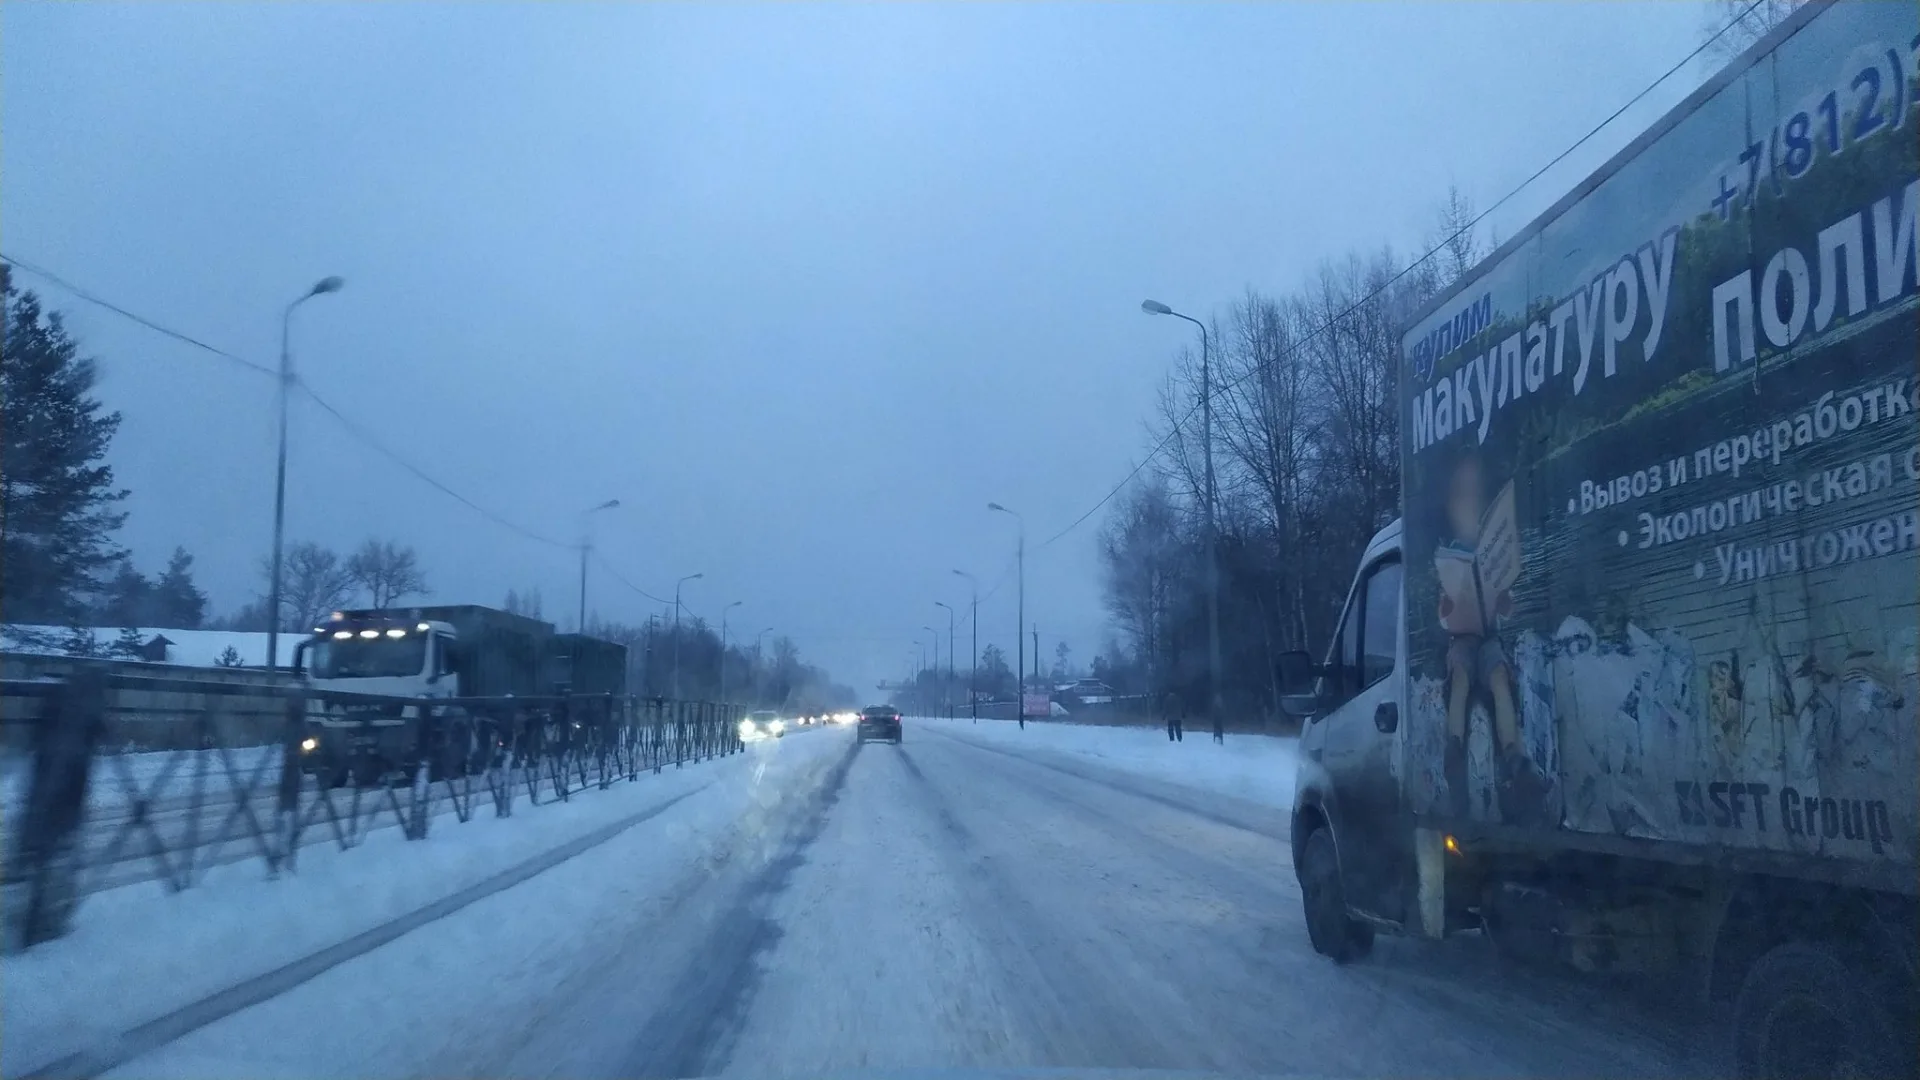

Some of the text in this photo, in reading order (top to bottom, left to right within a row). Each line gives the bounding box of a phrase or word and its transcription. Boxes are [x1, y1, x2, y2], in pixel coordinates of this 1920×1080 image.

[1412, 227, 1681, 454] макулатуру
[1580, 465, 1663, 515] Вывоз
[1668, 456, 1686, 487] и
[1636, 453, 1893, 549] Экологическая
[1780, 787, 1894, 855] Group
